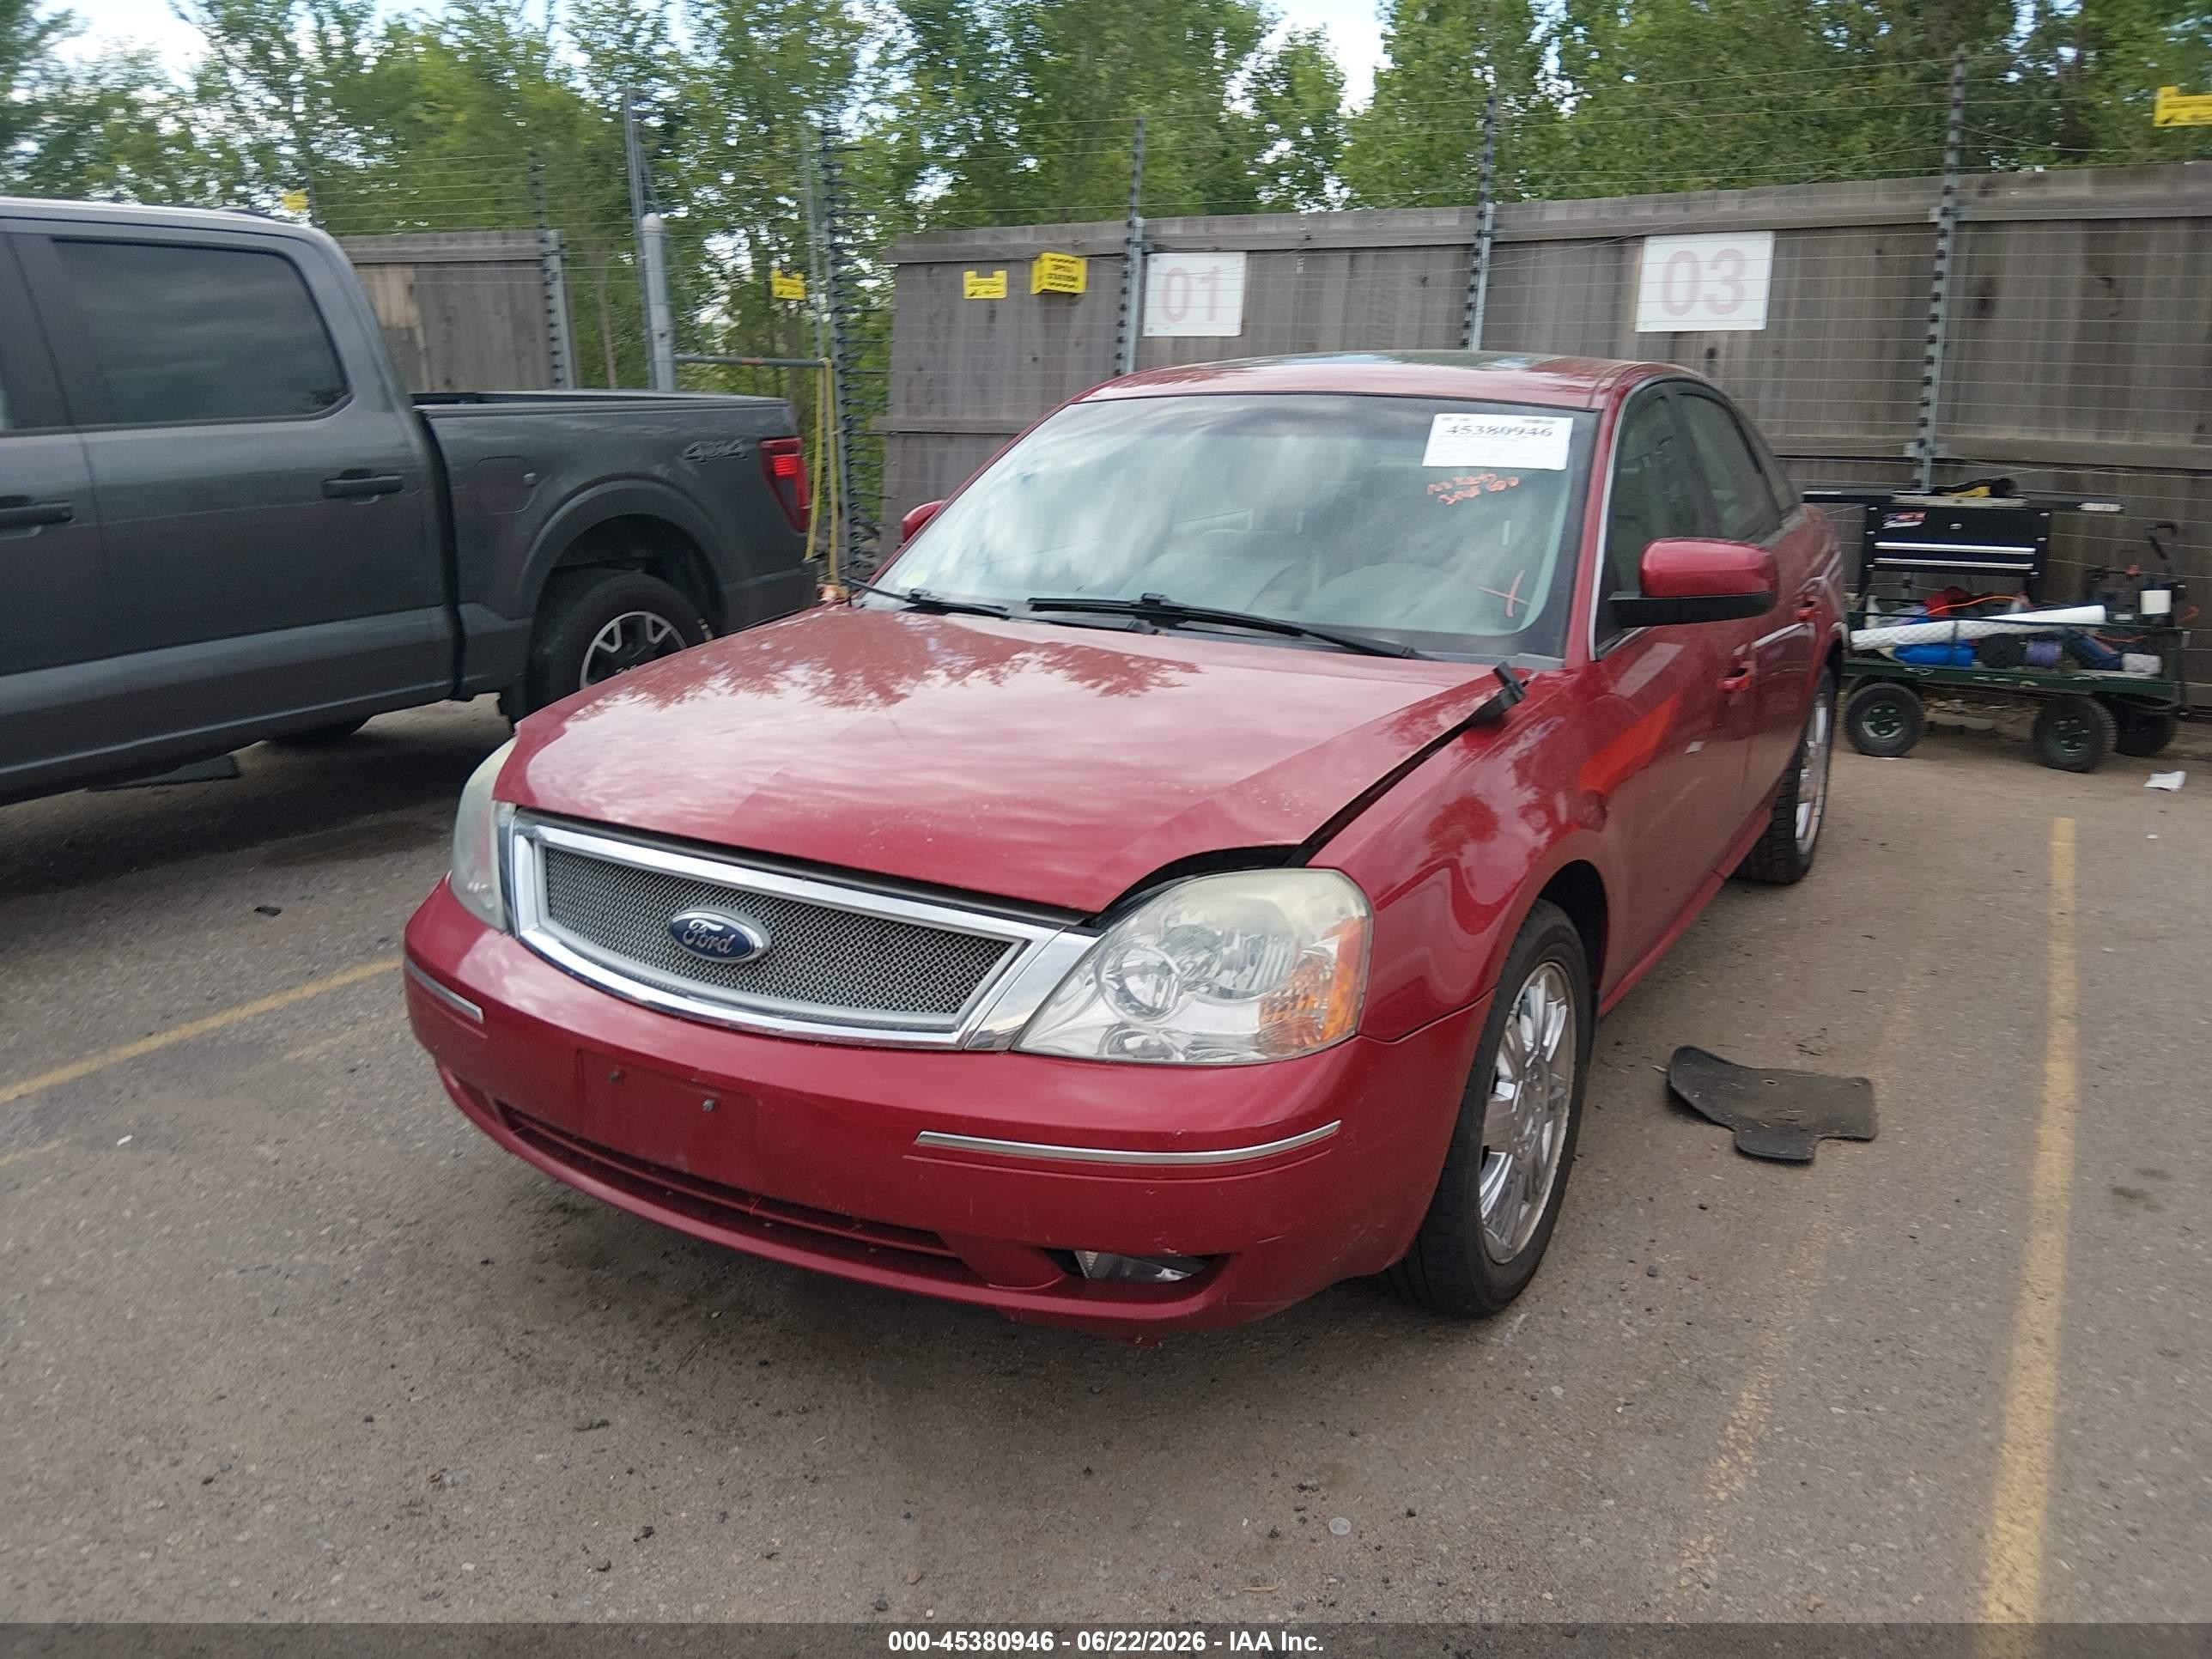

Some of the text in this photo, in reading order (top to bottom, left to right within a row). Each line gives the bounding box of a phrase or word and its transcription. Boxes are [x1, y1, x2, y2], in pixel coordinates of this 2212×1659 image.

[1161, 266, 1221, 323] 01
[1662, 248, 1746, 316] 03
[1445, 425, 1553, 437] 45380946
[683, 919, 736, 954] Ford
